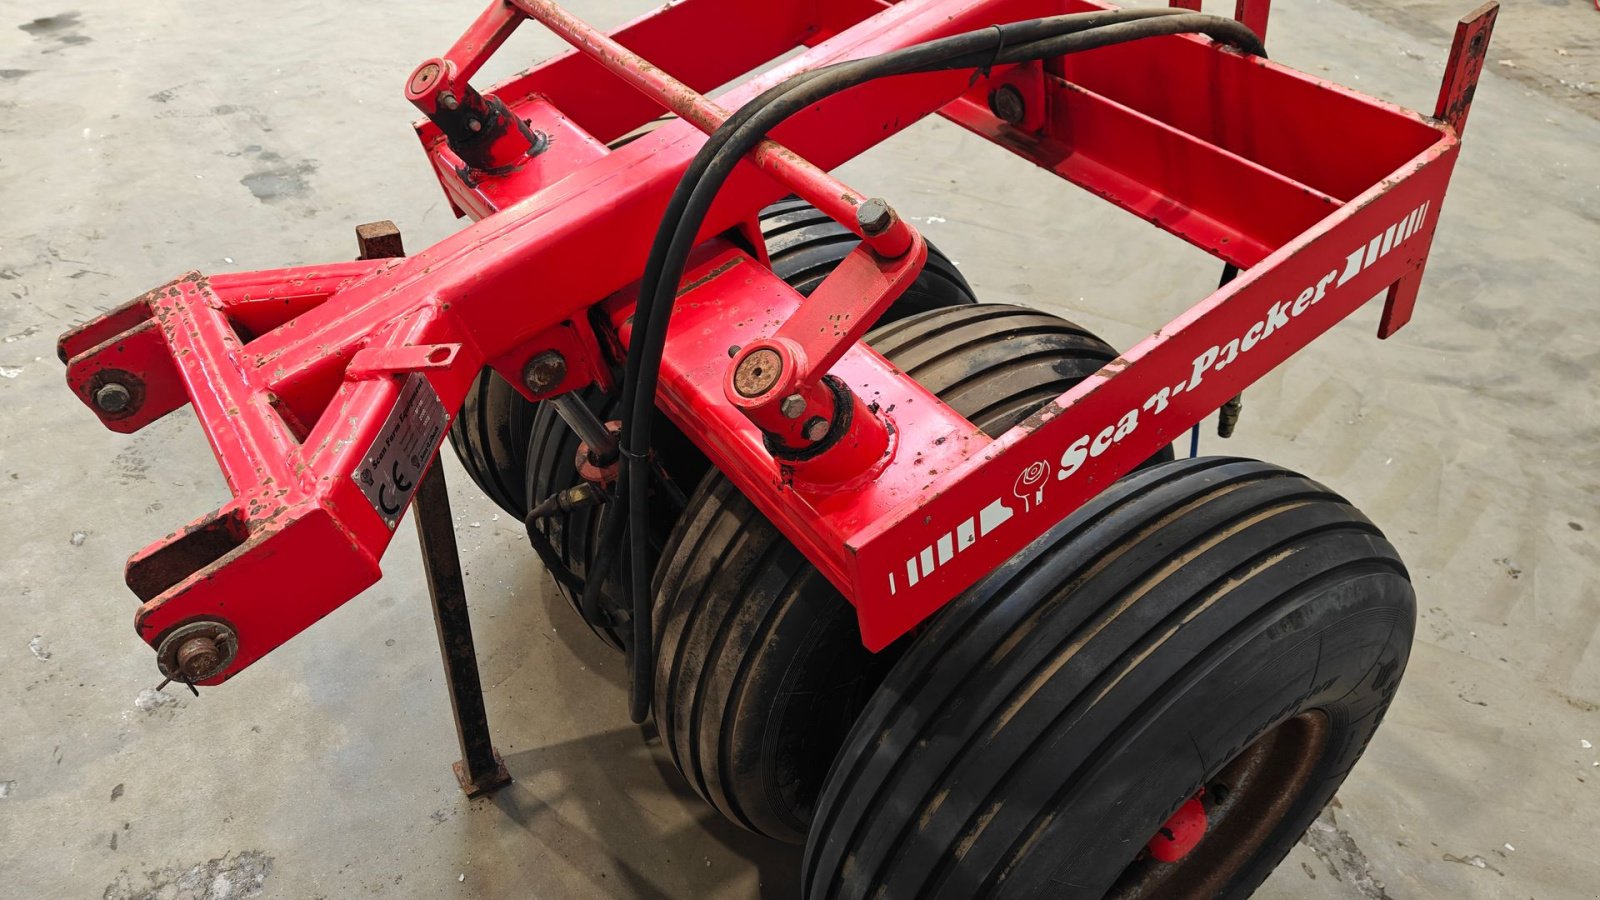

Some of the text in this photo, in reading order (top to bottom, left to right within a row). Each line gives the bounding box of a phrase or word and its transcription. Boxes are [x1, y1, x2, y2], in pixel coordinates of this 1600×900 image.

[372, 446, 387, 470] Scan
[386, 424, 400, 447] Farm
[400, 378, 424, 426] Equipment
[379, 460, 412, 515] CE
